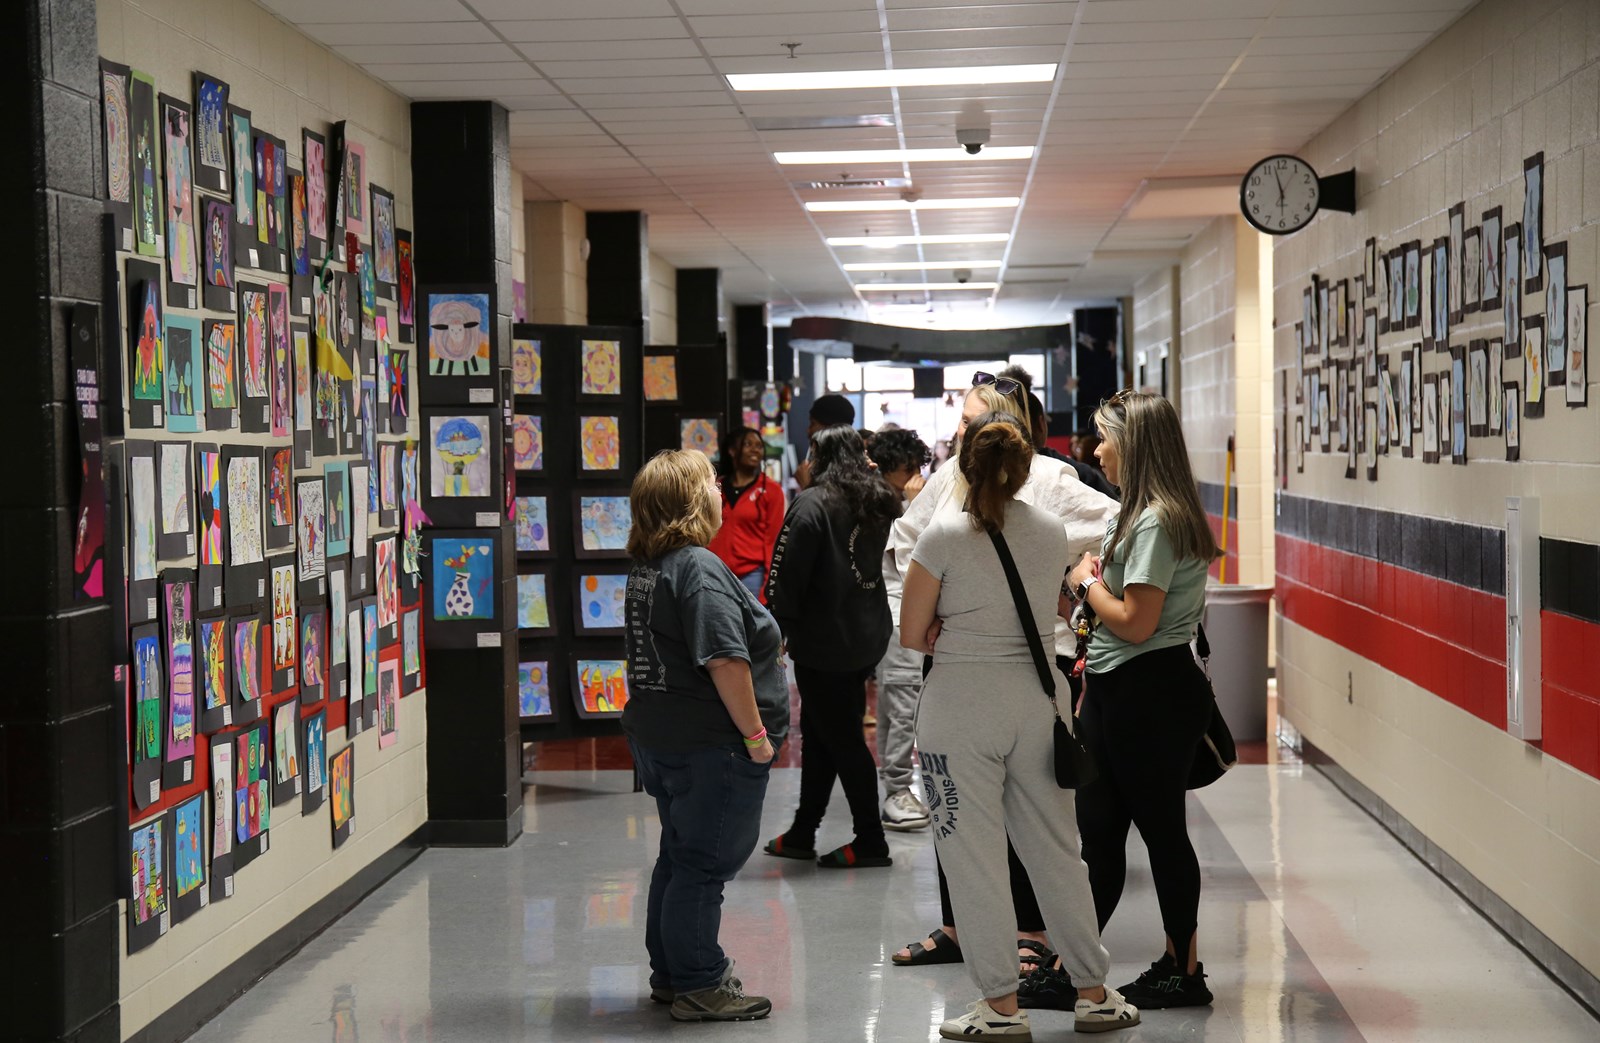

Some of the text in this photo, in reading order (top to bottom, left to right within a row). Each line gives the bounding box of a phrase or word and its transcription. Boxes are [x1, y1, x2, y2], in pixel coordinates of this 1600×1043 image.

[1263, 165, 1272, 175] 11
[1276, 160, 1288, 170] 12
[1251, 176, 1261, 186] 10
[1304, 174, 1311, 184] 2
[1248, 191, 1255, 200] 9
[1309, 188, 1315, 198] 3
[1252, 204, 1260, 214] 8
[1304, 203, 1311, 212] 4
[1265, 216, 1271, 225] 7
[1279, 218, 1286, 228] 6
[1294, 214, 1300, 224] 5
[769, 525, 791, 596] AMERICAN
